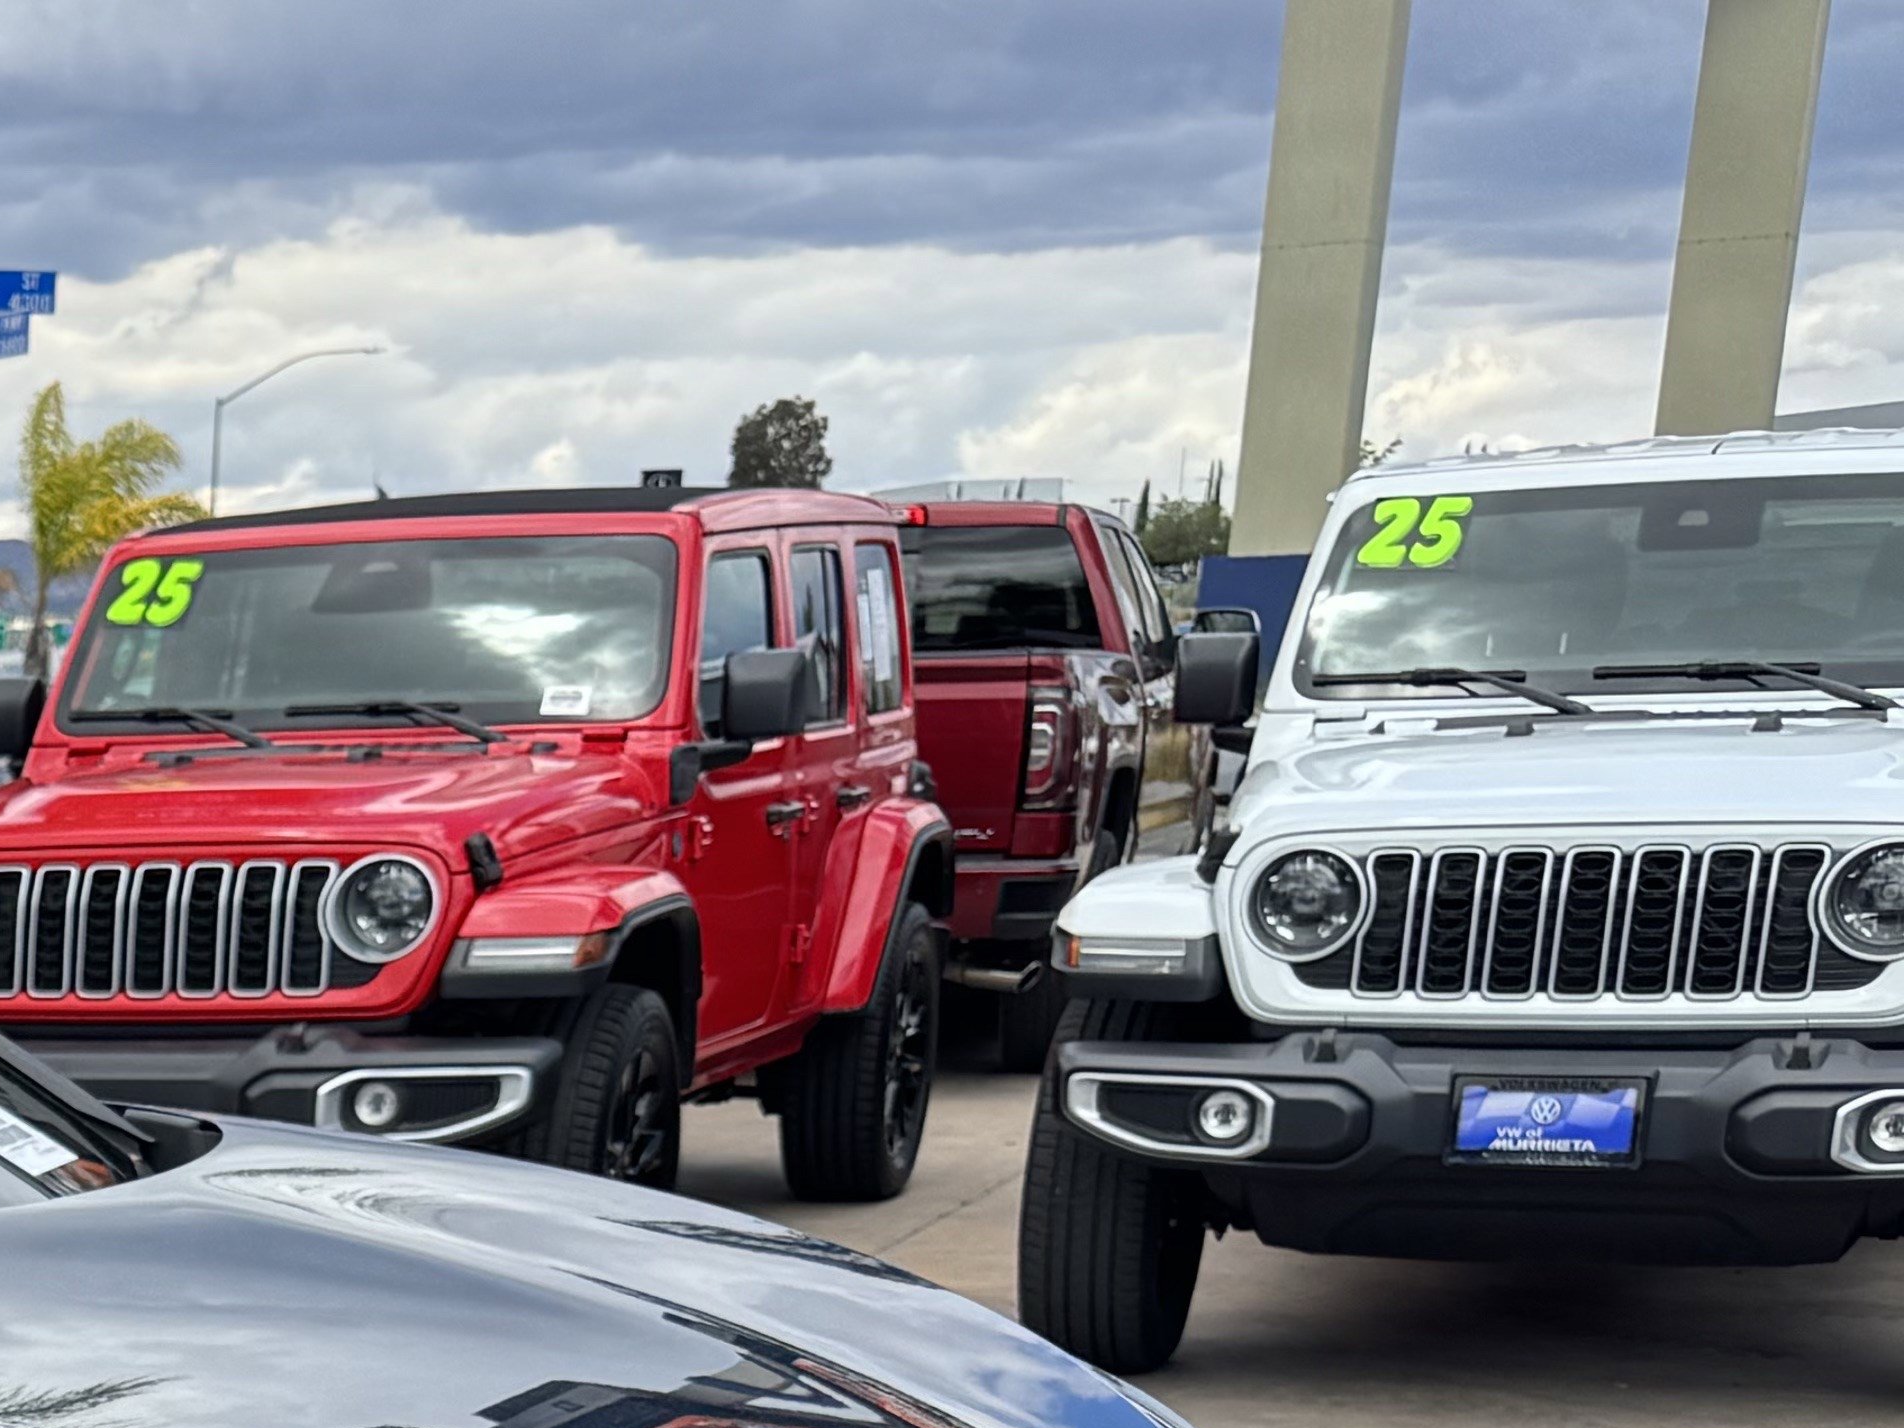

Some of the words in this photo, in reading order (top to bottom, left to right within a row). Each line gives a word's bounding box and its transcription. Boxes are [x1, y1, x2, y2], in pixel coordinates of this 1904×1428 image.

[1357, 496, 1472, 568] 25
[106, 558, 204, 627] 25
[1488, 1139, 1597, 1152] MURRIETA
[1496, 1126, 1523, 1138] VW
[1525, 1126, 1543, 1138] of
